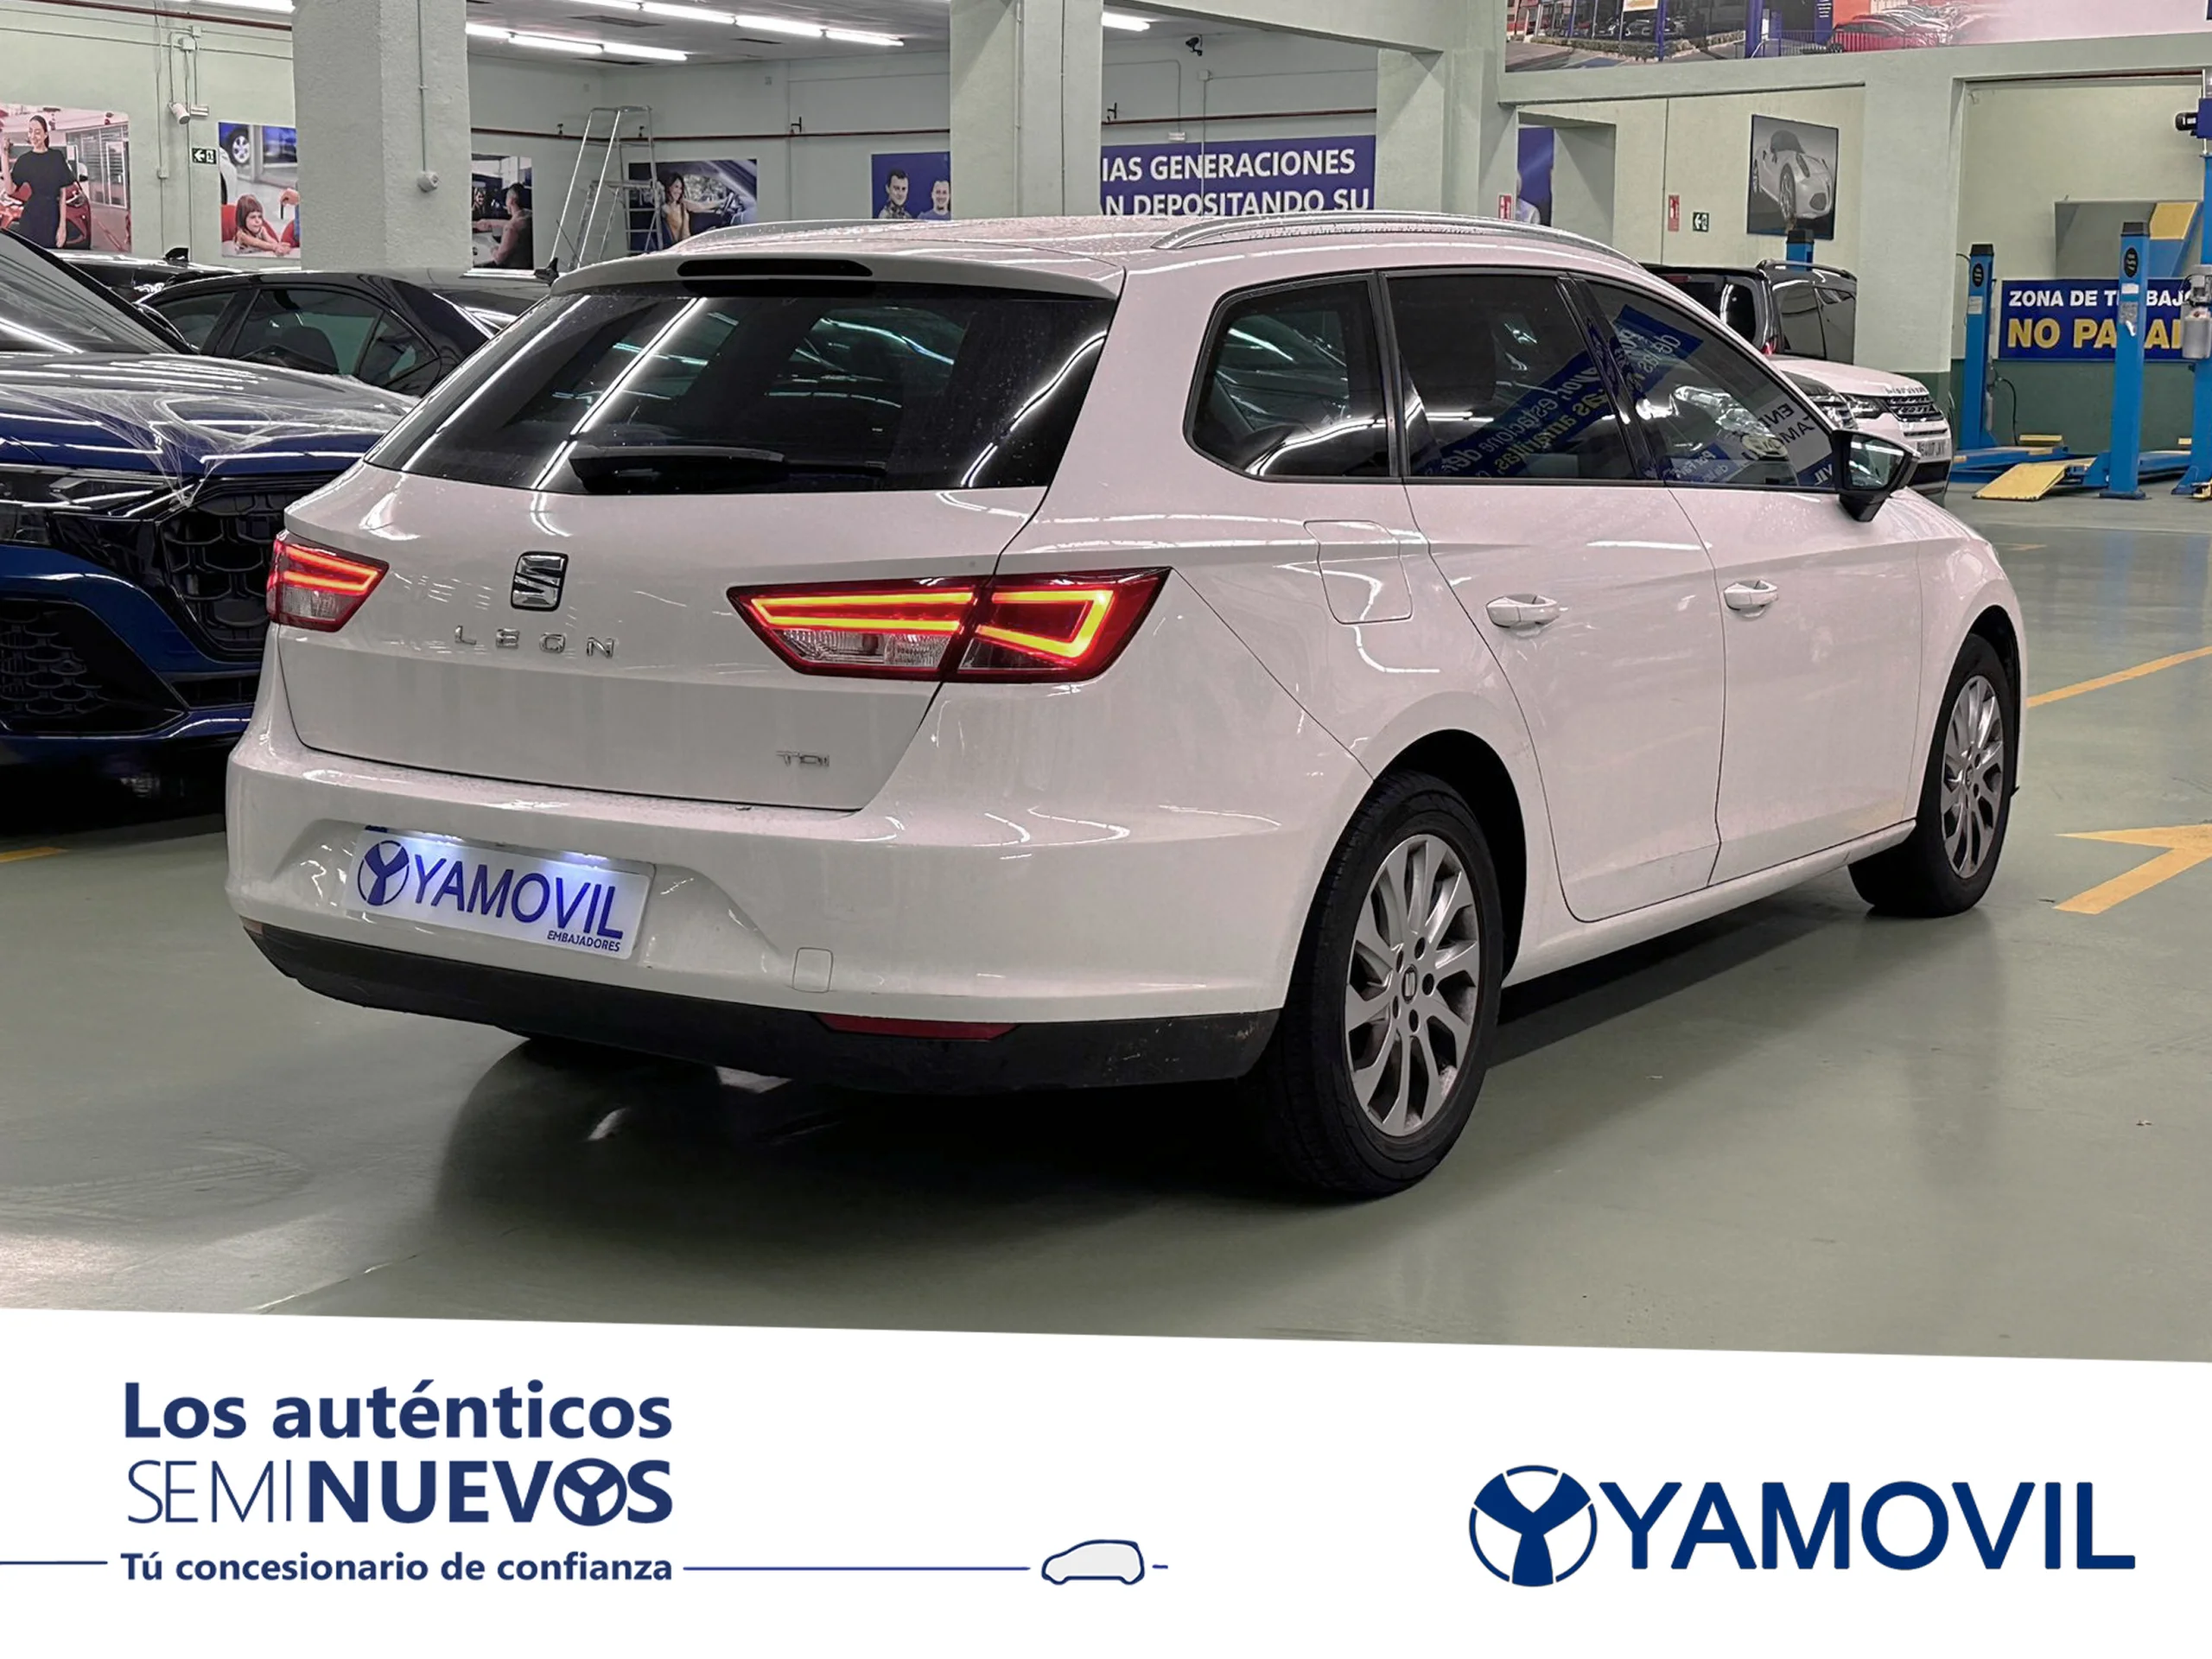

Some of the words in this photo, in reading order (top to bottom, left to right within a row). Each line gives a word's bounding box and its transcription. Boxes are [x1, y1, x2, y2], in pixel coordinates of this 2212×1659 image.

[1150, 149, 1356, 180] GENERACIONES
[1133, 189, 1325, 215] DEPOSITANDO
[1333, 188, 1370, 211] SU
[2009, 289, 2063, 307] ZONA
[2069, 289, 2097, 307] DE
[2007, 318, 2060, 348] NO
[2073, 318, 2183, 348] PAA
[454, 625, 615, 658] LEON
[777, 750, 830, 768] TDI
[415, 854, 623, 940] YAMOVIL
[546, 930, 621, 953] EMBAJADORES
